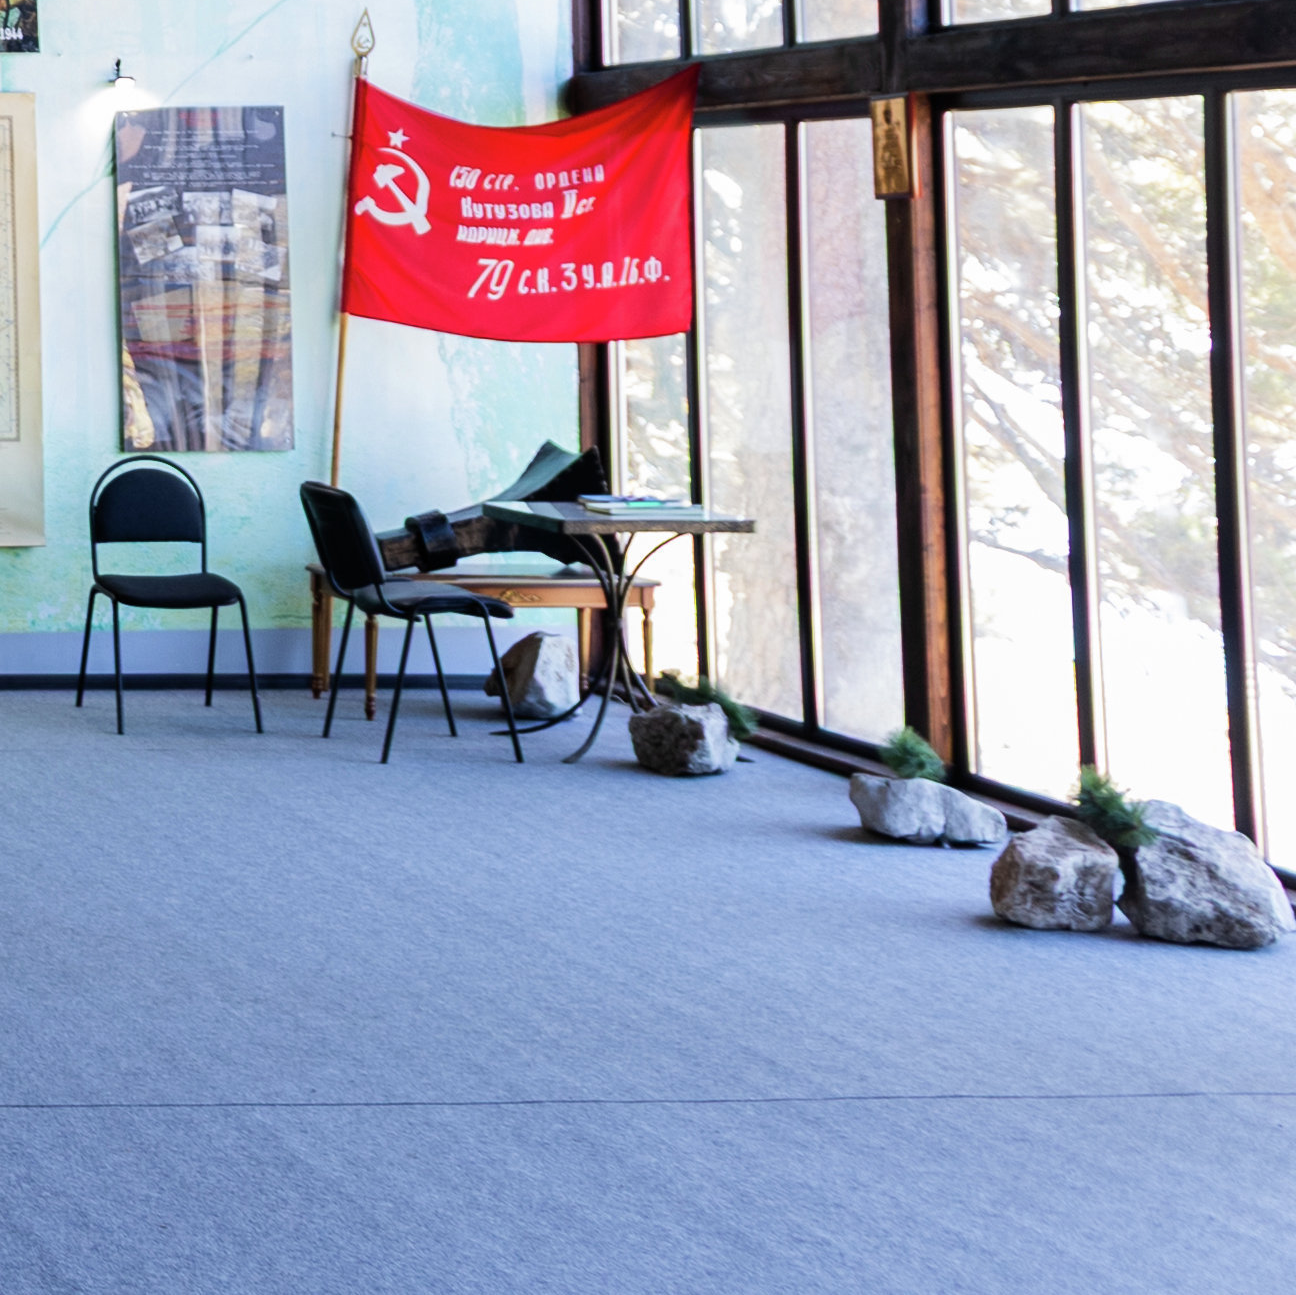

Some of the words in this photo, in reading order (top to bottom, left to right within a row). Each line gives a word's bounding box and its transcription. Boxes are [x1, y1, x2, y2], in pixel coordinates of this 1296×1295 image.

[0, 27, 24, 41] 1944
[449, 164, 482, 191] 150
[466, 257, 515, 301] 79
